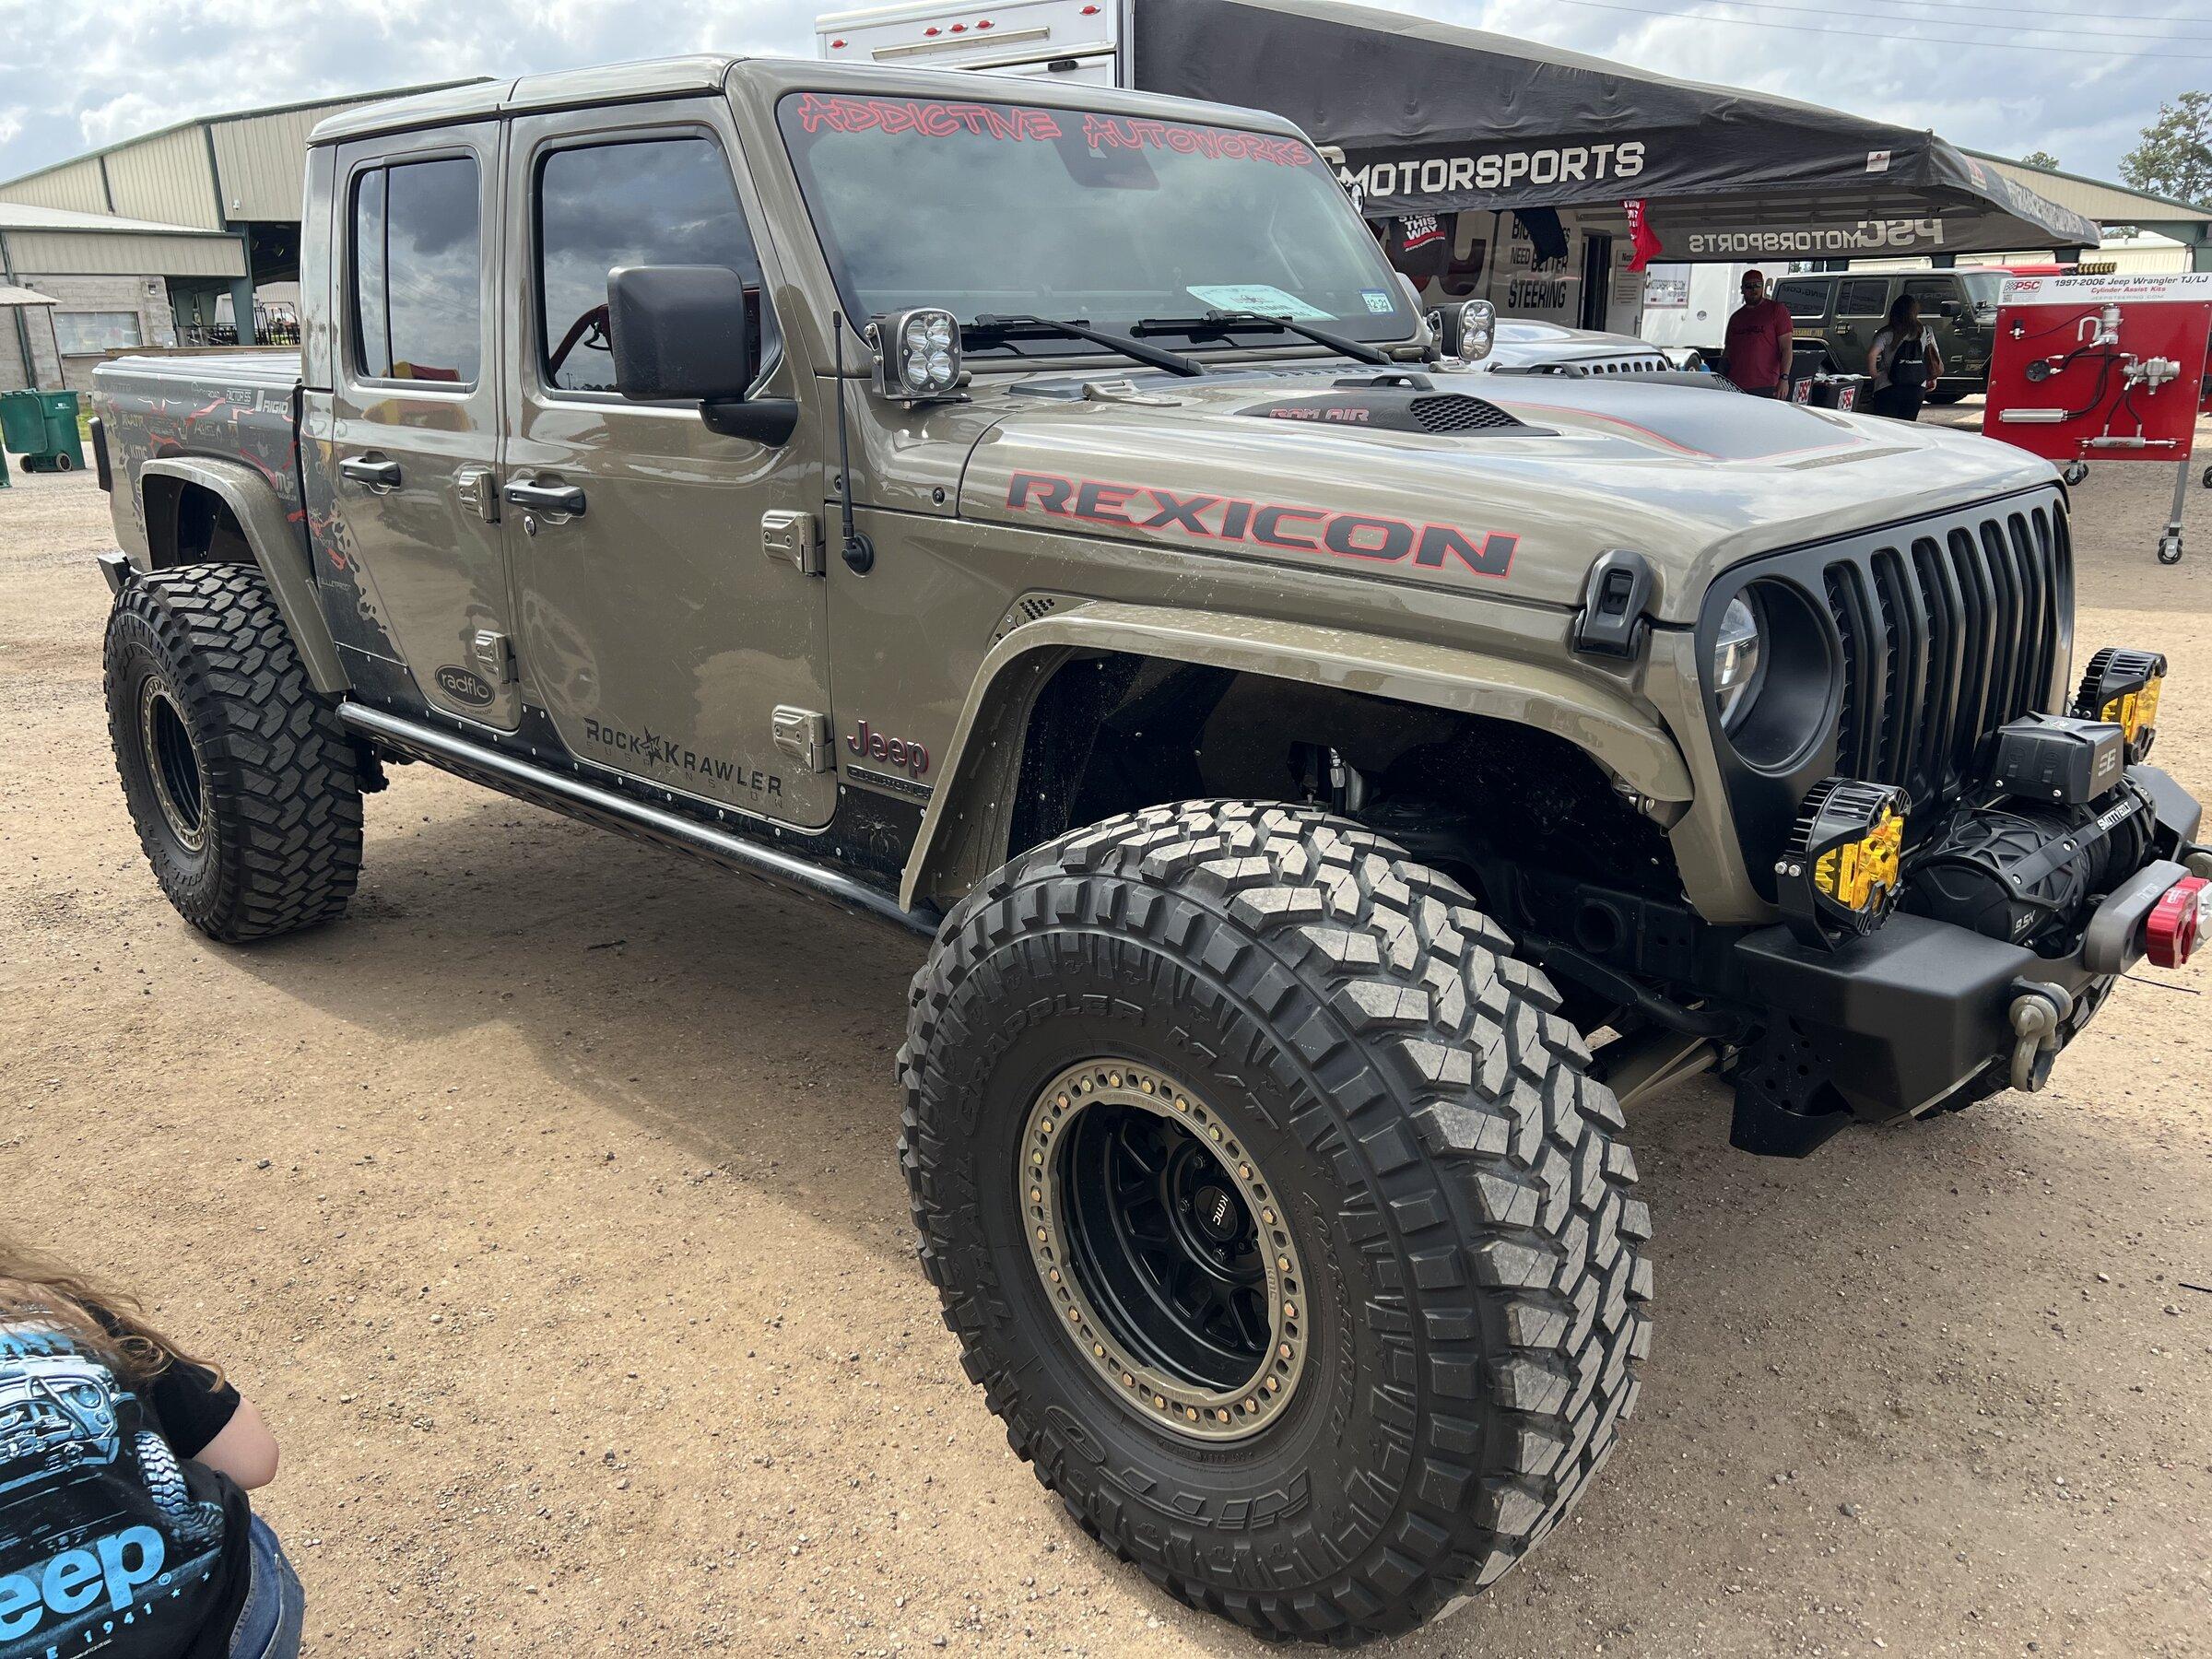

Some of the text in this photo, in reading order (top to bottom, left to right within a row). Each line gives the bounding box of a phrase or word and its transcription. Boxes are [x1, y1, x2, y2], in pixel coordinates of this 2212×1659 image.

[798, 93, 1062, 142] ADDICTIVE
[1083, 112, 1312, 167] AUTOWORKS
[1339, 141, 1645, 197] MOTORSPORTS
[1404, 216, 1437, 231] THIS
[1406, 224, 1438, 240] WAY
[1511, 246, 1530, 265] NEED
[1508, 279, 1567, 308] STEERING
[2014, 275, 2208, 291] PSC 1997-2006 Jeep Wrangler TJ/LJ
[226, 389, 242, 402] FACTOR
[263, 400, 289, 415] RIGID
[1269, 408, 1370, 421] RAM AIR
[1005, 469, 1521, 579] REXICON
[441, 673, 489, 699] radflo
[582, 717, 783, 798] ROCK KRAWLER
[846, 719, 929, 779] Jeep
[586, 741, 783, 809] SUSPENSION
[2014, 910, 2036, 935] 9.5K
[1212, 1194, 1229, 1226] KMC
[0, 1525, 166, 1641] eep
[84, 1602, 153, 1643] 1941
